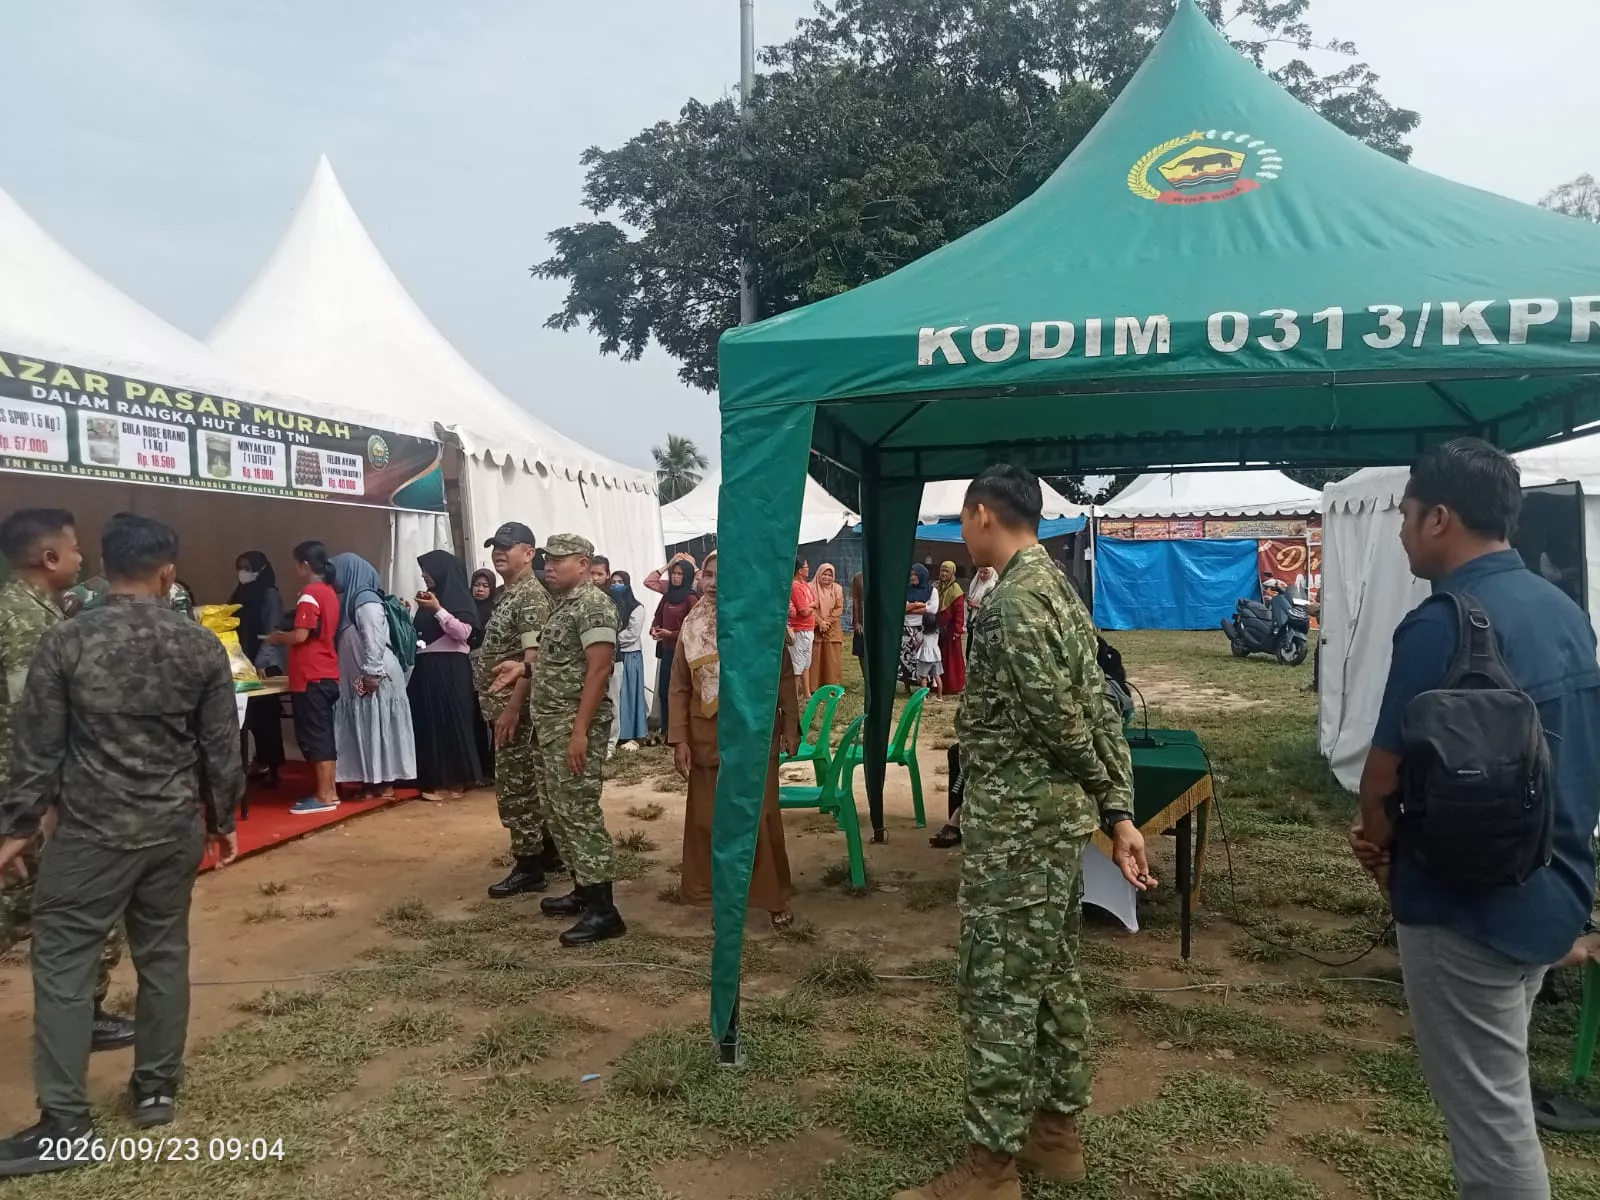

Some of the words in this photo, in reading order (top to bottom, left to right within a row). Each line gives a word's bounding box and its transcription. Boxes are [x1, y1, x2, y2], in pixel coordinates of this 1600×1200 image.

[918, 315, 1171, 367] KODIM
[32, 386, 109, 411] DALAM
[116, 401, 196, 426] RANGKA
[202, 416, 236, 432] HUT
[241, 423, 283, 440] KE-81
[287, 431, 310, 444] TNI
[125, 381, 241, 420] PASAR
[254, 407, 351, 441] MURAH
[14, 436, 49, 454] 57.000
[122, 422, 141, 436] GULA
[163, 428, 186, 442] BRAND
[238, 440, 261, 454] MINYAK
